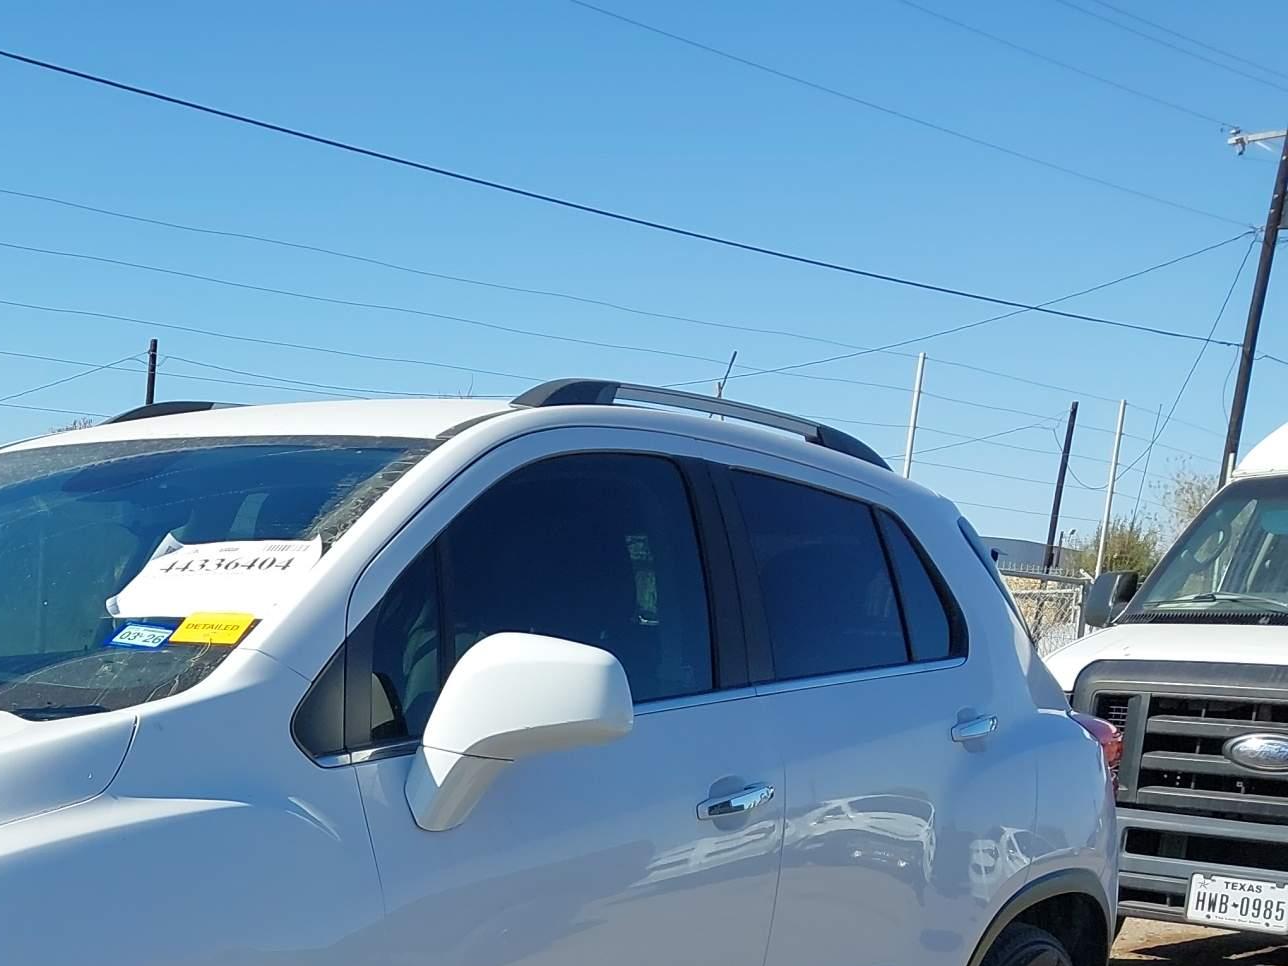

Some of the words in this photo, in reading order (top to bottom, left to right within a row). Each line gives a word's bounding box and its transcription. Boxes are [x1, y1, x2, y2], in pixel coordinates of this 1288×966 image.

[160, 556, 295, 573] 44336404
[185, 622, 240, 632] DETAILED
[1224, 881, 1262, 893] TEXAS
